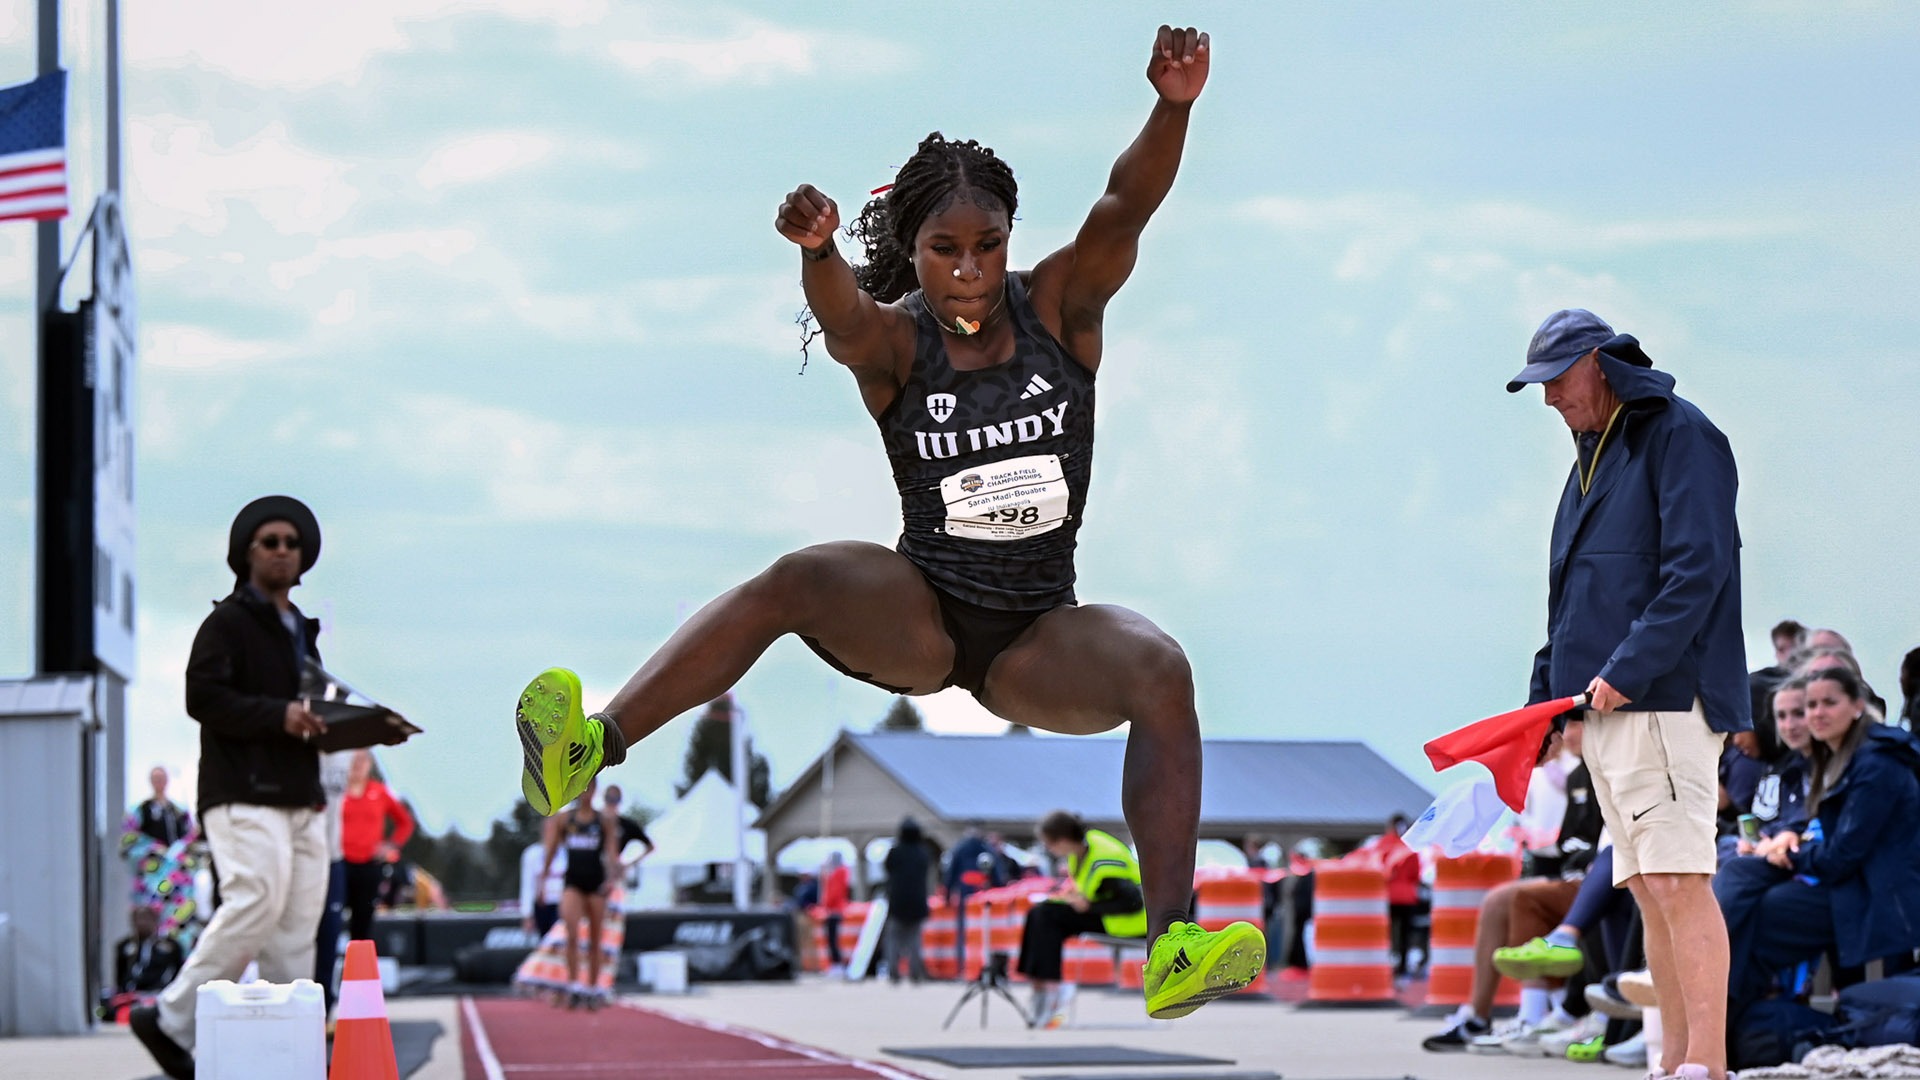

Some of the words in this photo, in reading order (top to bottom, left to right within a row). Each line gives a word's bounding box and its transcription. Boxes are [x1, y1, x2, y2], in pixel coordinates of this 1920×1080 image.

[914, 431, 959, 460] IU
[966, 400, 1068, 451] INDY
[986, 473, 1042, 488] CHAMPIONSHIPS
[990, 471, 1012, 481] TRACK
[967, 497, 991, 508] Sarah
[992, 486, 1047, 502] Madi-Bouabre
